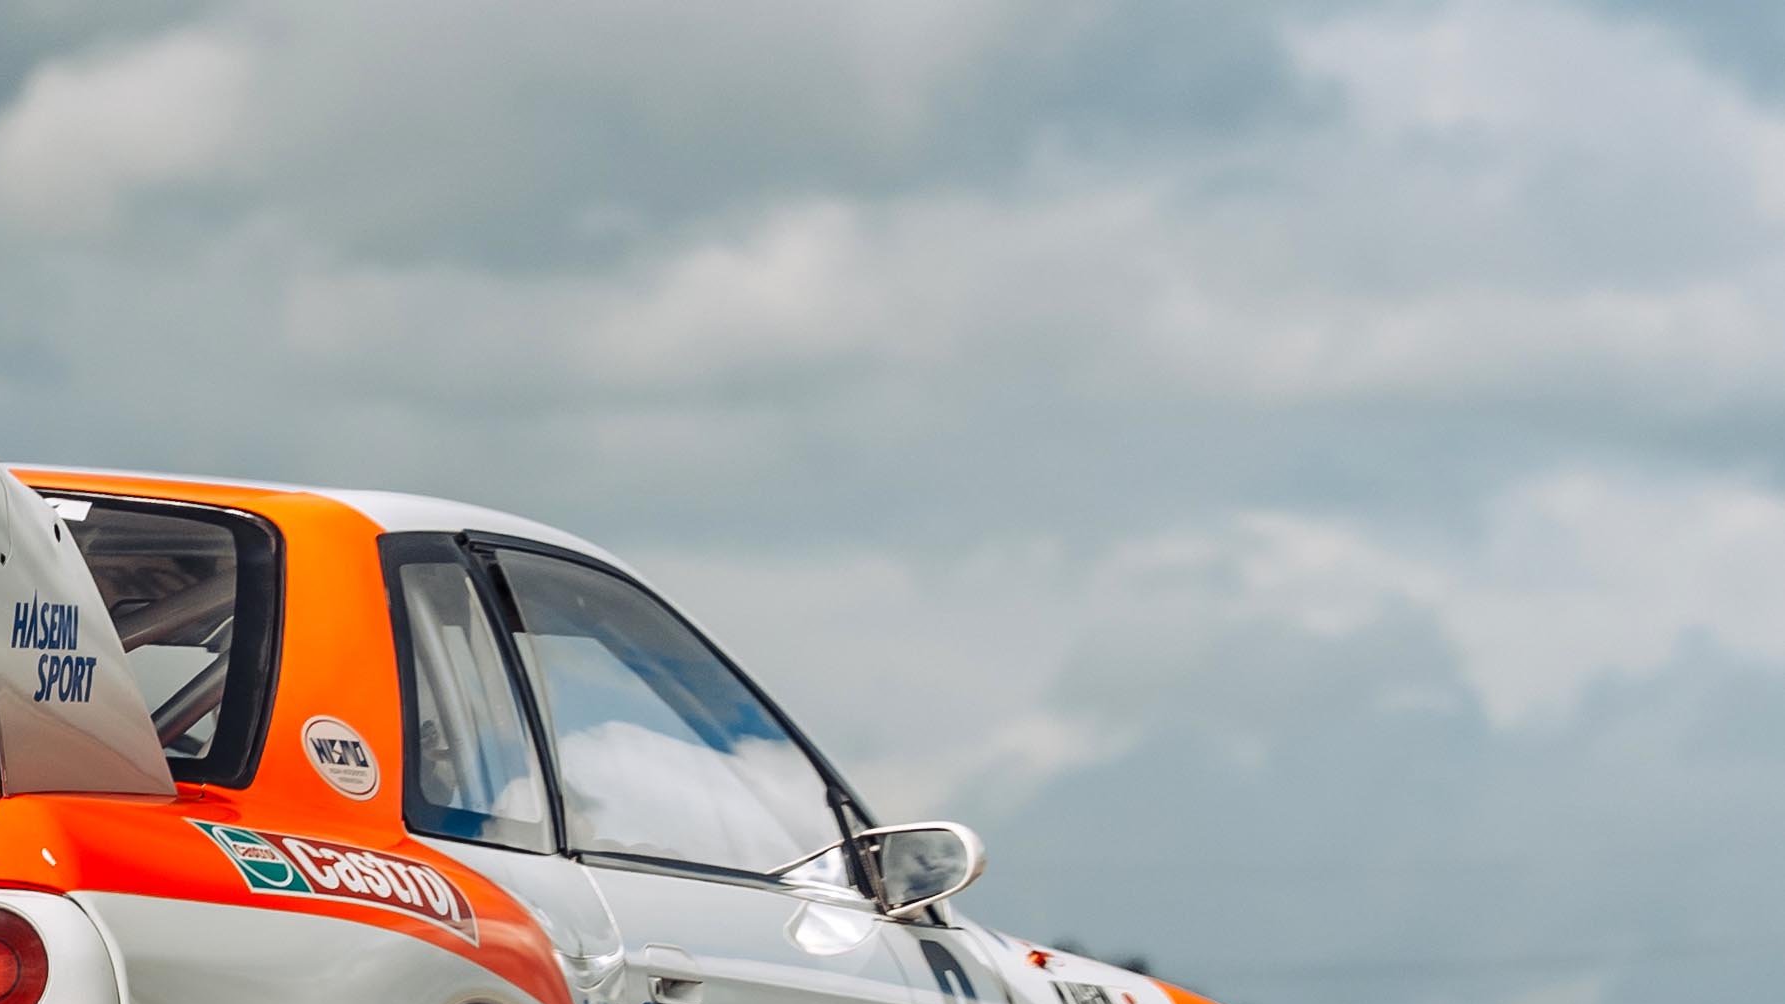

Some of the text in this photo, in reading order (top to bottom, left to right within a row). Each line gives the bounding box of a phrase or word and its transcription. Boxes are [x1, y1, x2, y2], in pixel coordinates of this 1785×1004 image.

[11, 589, 79, 650] HASEMI
[33, 655, 97, 703] SPORT
[282, 837, 462, 923] Castrol
